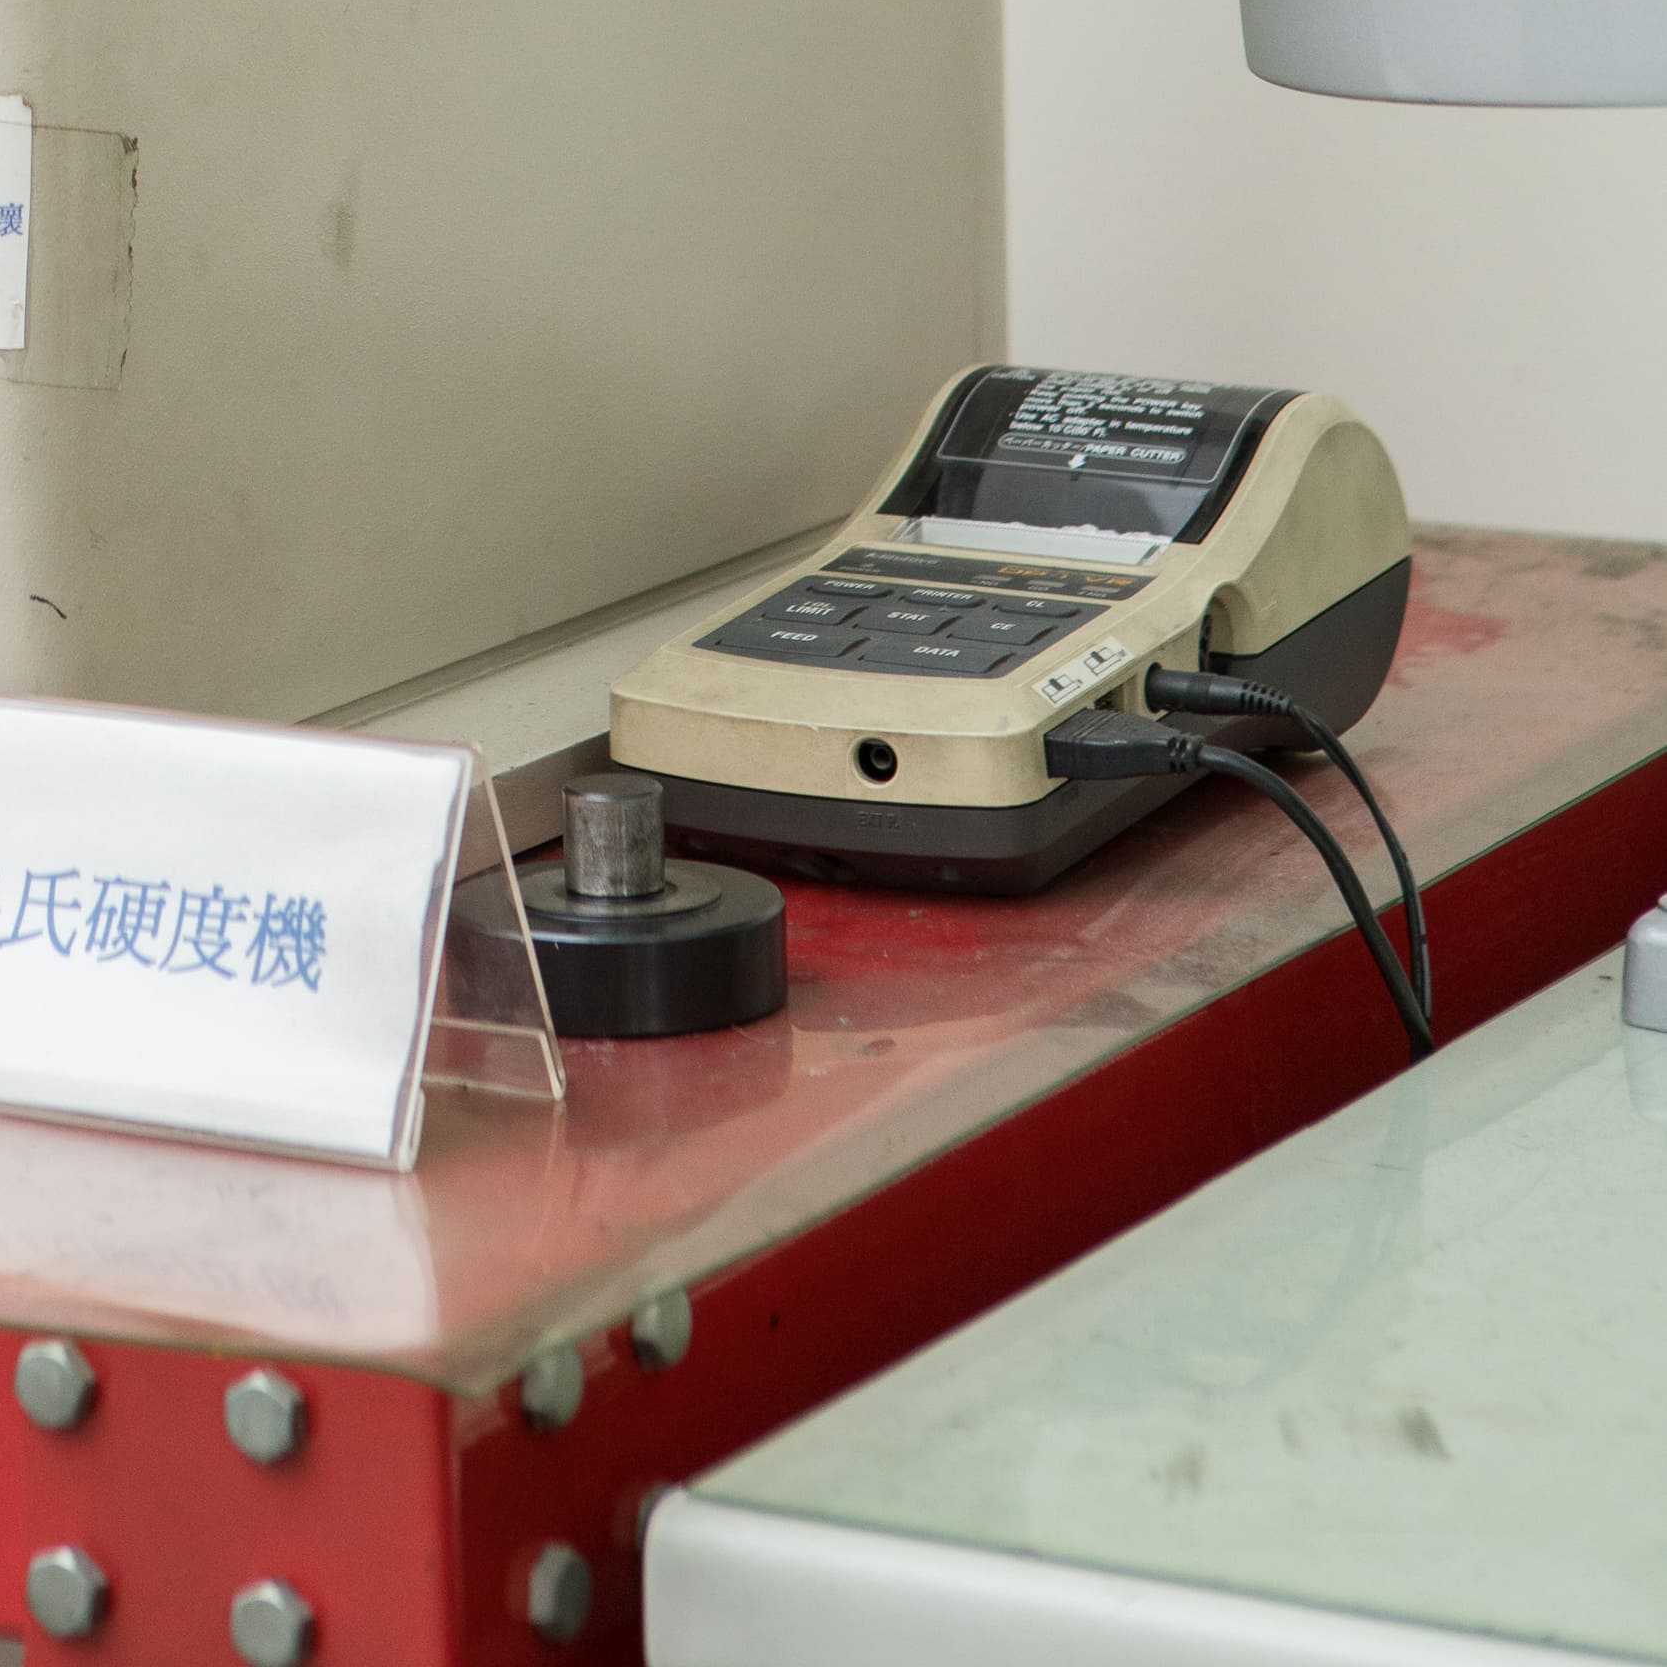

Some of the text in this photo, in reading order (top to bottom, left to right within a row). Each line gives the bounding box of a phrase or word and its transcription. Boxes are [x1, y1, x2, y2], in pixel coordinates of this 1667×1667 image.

[1040, 413, 1061, 423] AC
[1124, 421, 1194, 435] temperature
[1129, 447, 1185, 461] CUTTER
[824, 580, 974, 601] POWER PRINTER
[786, 604, 1016, 631] LIMIT STAT CE
[770, 630, 961, 658] FEED DATA
